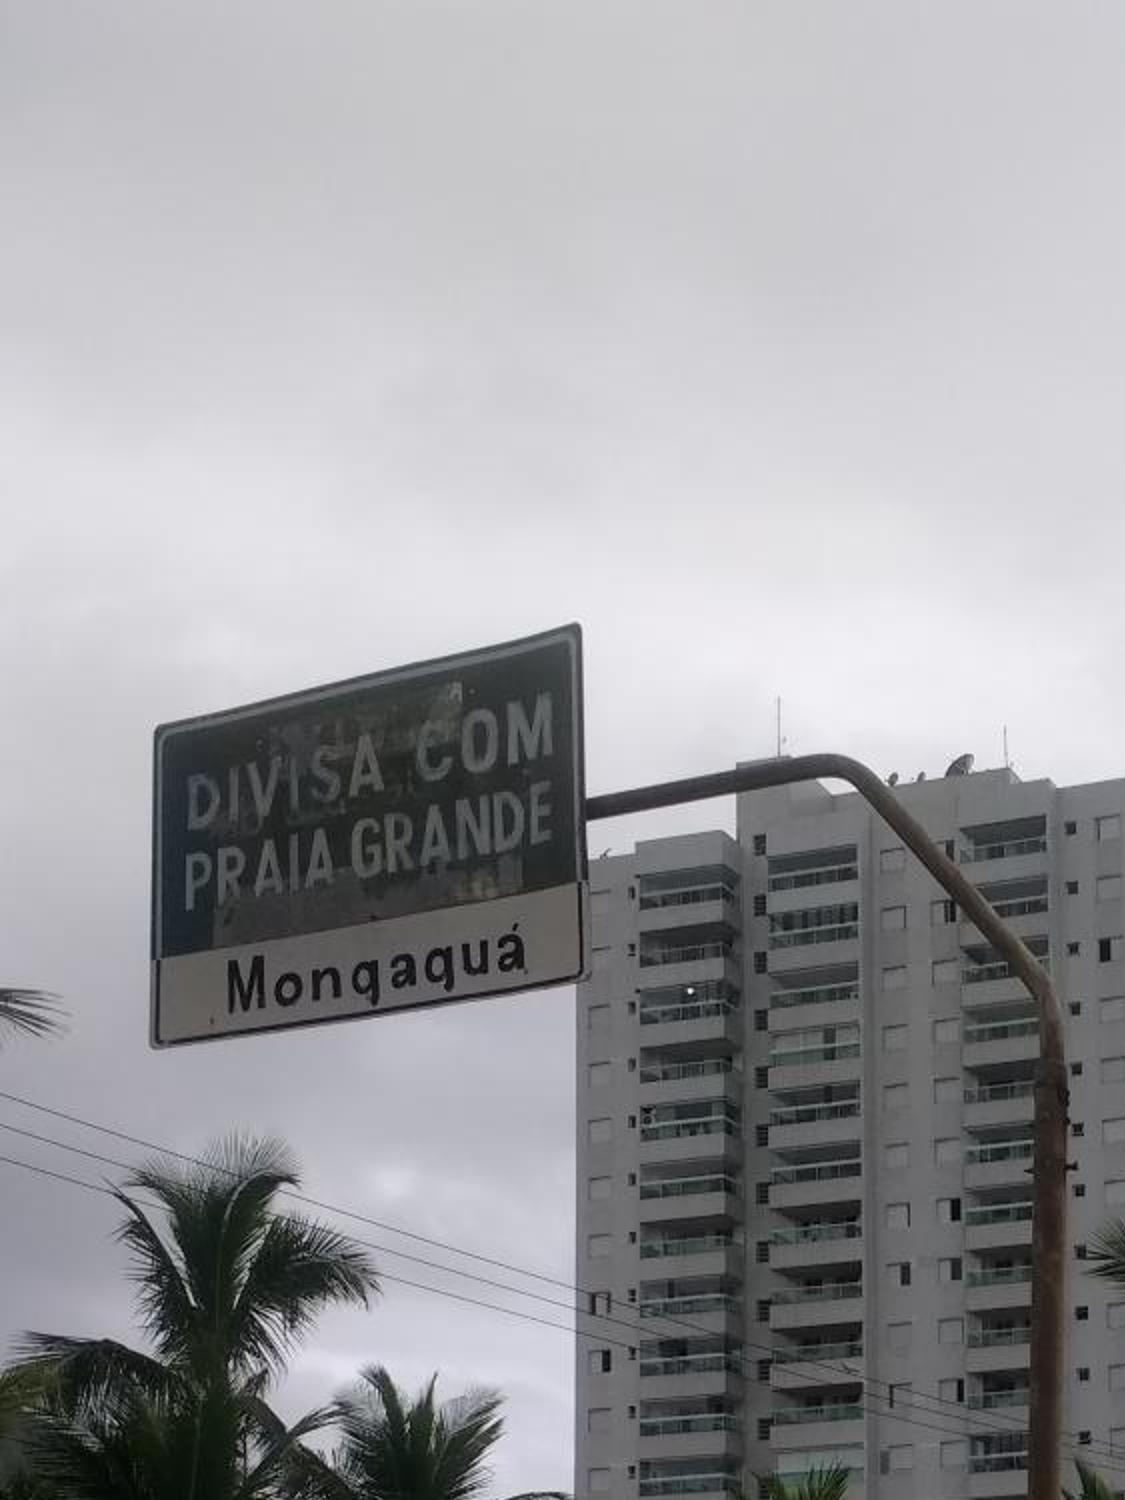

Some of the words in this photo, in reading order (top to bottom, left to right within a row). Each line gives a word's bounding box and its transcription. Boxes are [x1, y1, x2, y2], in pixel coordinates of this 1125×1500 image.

[186, 734, 386, 832] DIVISA
[417, 693, 553, 782] COM
[185, 828, 334, 911] PRAIA
[351, 780, 552, 880] GRANDE
